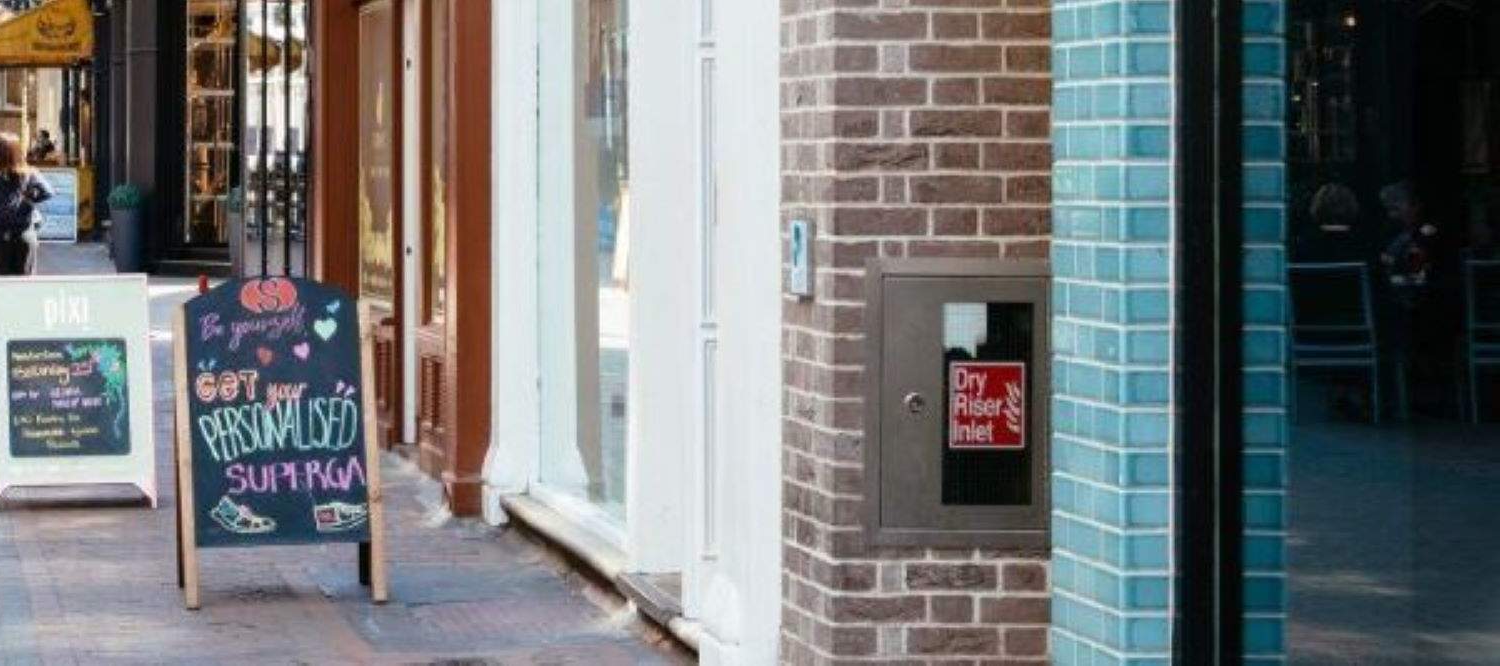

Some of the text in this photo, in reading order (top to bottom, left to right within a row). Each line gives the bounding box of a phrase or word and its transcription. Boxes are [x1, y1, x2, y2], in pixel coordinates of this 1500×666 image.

[200, 312, 225, 342] Be
[195, 371, 259, 402] GET
[955, 368, 987, 396] Dry
[954, 392, 1003, 417] Riser
[199, 397, 359, 461] PERSONALISED
[954, 419, 995, 443] Inlet
